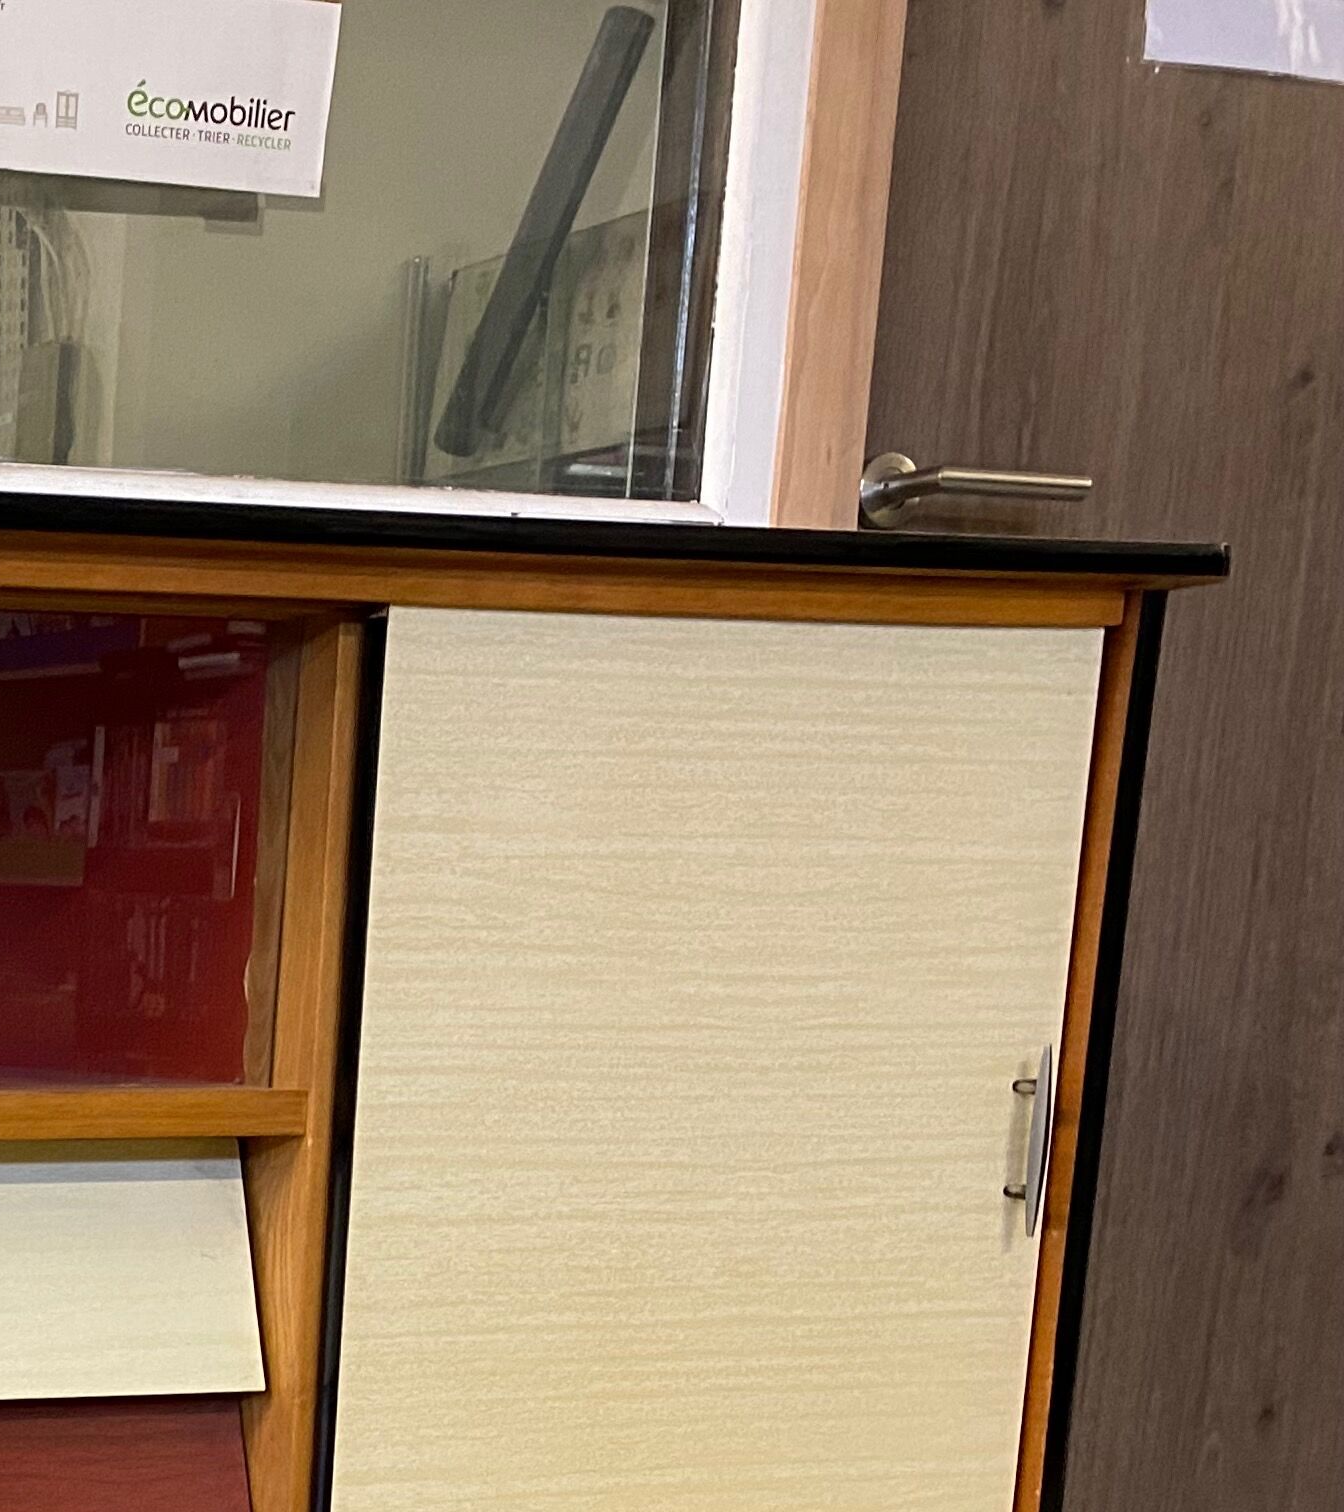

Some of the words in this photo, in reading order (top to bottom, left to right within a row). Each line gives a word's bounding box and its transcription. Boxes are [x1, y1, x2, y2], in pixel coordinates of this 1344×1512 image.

[125, 123, 190, 141] COLLECTER
[198, 130, 230, 145] TRIER
[237, 133, 292, 151] RECYCLER
